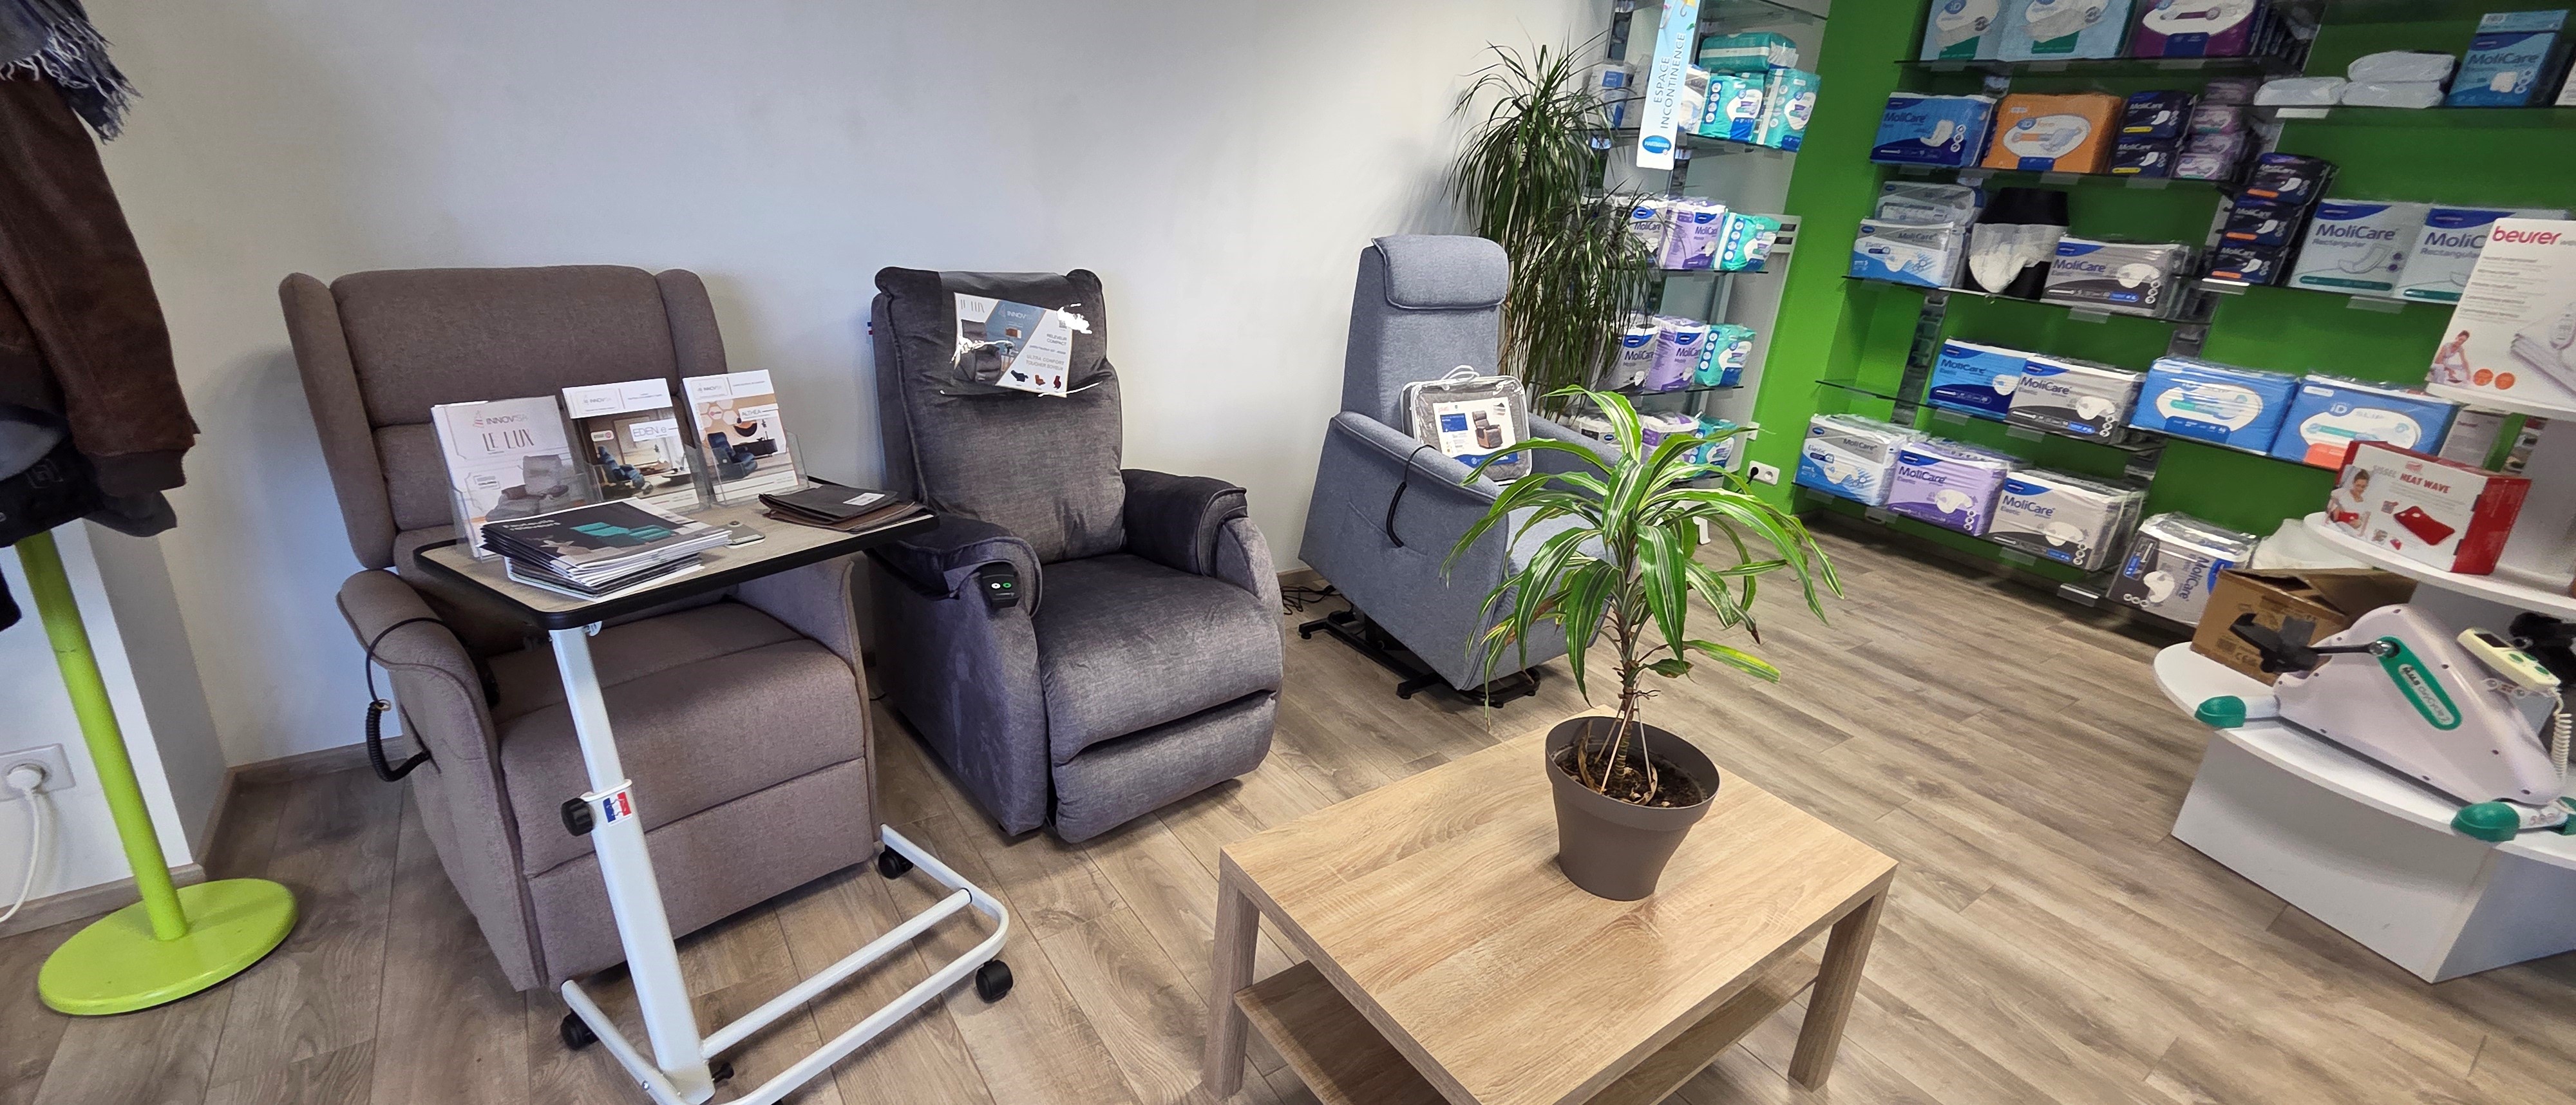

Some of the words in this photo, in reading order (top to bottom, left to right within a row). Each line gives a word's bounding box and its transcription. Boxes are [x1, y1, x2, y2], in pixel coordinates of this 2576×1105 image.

[2468, 53, 2539, 65] MoliCare
[1653, 57, 1671, 103] ESPACE
[1660, 33, 1686, 129] INCONTINENCE
[1884, 112, 1927, 124] MoliCare
[1898, 232, 1938, 241] MoliCare
[2316, 224, 2396, 240] MoliCare
[2492, 225, 2562, 245] beurer
[2312, 238, 2366, 247] Rectangular
[2424, 232, 2486, 249] MoliC
[2420, 247, 2481, 259] Rectangula
[2052, 259, 2106, 272] MoliCare
[1940, 358, 1986, 374] MoliCare
[2020, 376, 2070, 395] MoliCare
[2331, 402, 2349, 415] iD
[633, 426, 659, 437] EDEN
[482, 432, 499, 451] LE
[504, 429, 535, 449] LUX
[1899, 466, 1946, 484] MoliCare
[2400, 473, 2423, 485] HEAT
[2423, 479, 2451, 493] WAVE
[2002, 495, 2054, 516] MoliCare
[2179, 556, 2210, 600] MoliCare
